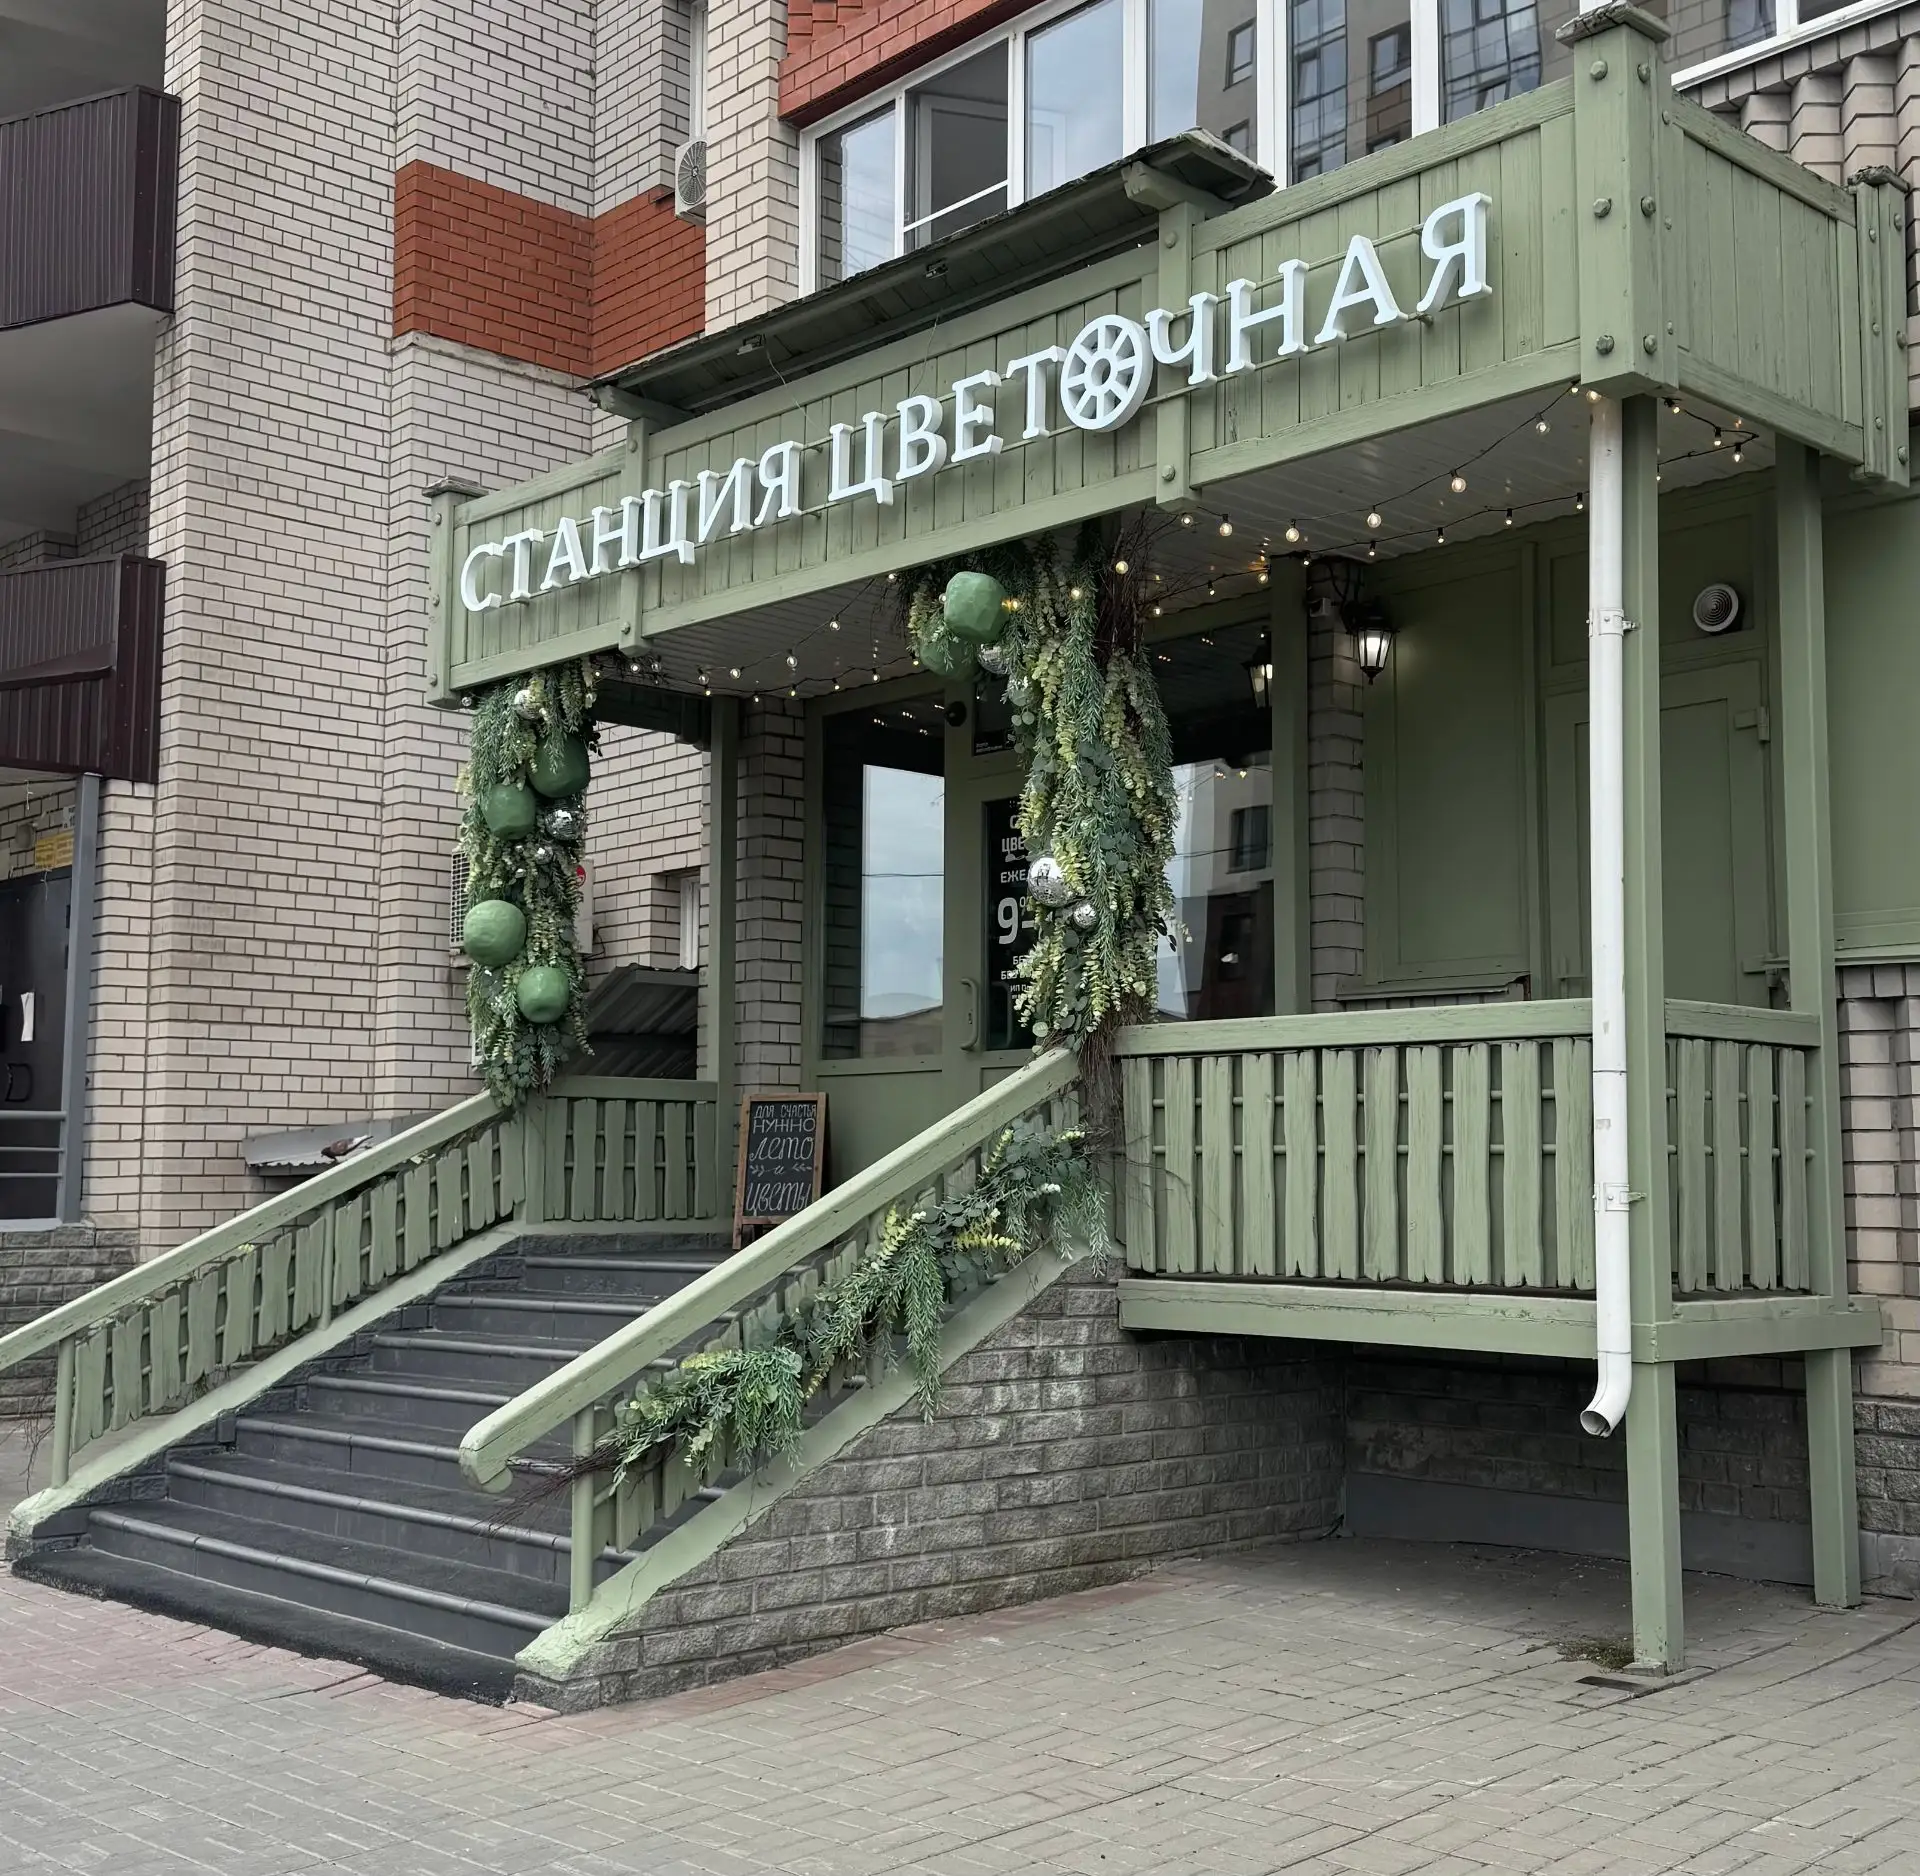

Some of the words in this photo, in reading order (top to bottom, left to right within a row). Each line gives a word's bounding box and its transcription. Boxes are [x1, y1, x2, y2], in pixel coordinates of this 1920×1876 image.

[461, 440, 804, 612] СТАНЦИЯ
[828, 192, 1492, 506] ЦВЕТОЧНАЯ
[753, 1105, 775, 1119] ДЛЯ
[780, 1104, 817, 1118] СЧАСТЬЯ
[753, 1118, 816, 1134] НУЖНО
